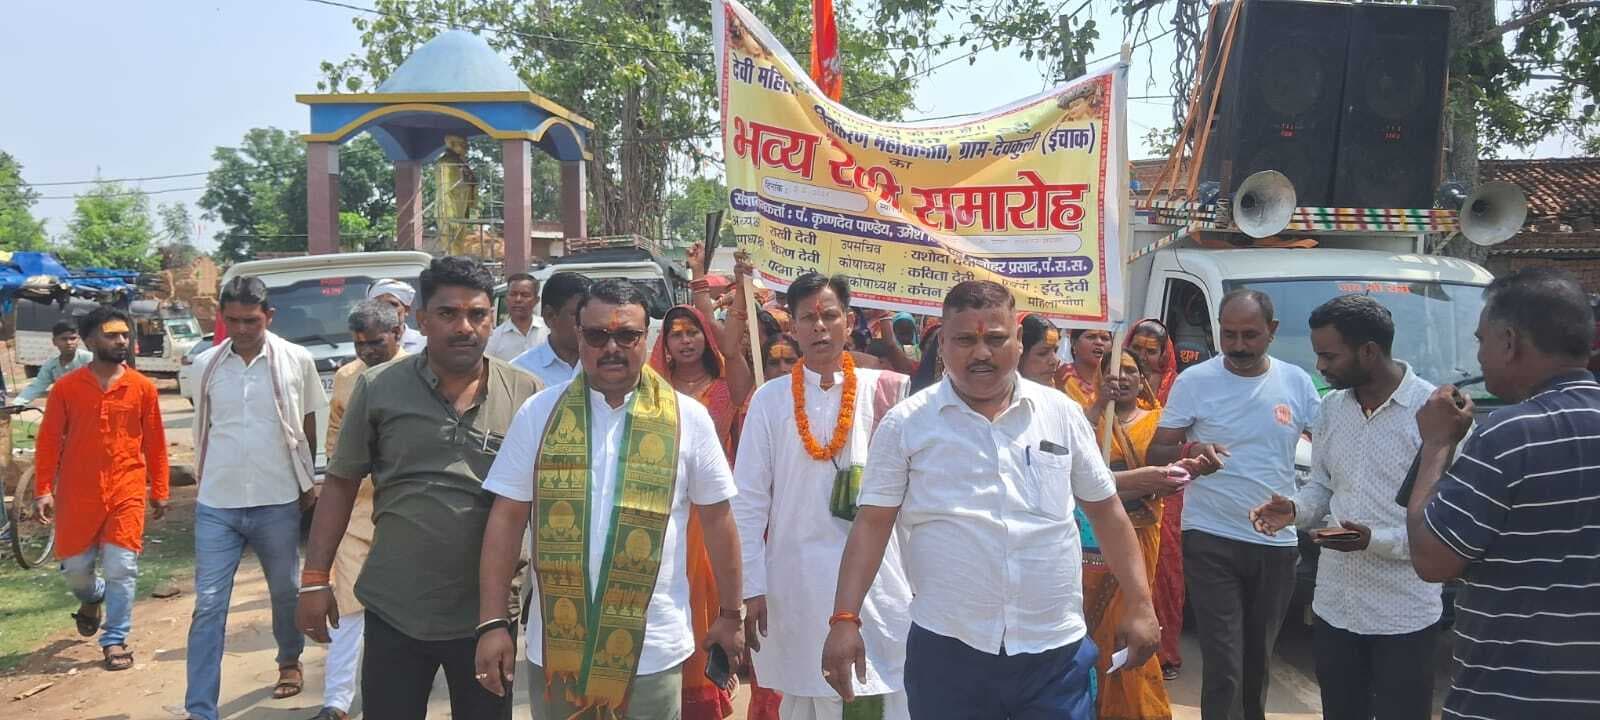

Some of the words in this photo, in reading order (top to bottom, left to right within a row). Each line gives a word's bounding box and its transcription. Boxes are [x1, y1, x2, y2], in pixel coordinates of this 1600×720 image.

[733, 52, 755, 84] देवी
[889, 157, 913, 170] का
[733, 116, 822, 180] भव्य
[911, 170, 1090, 232] समारोह
[795, 229, 817, 246] देवी
[798, 248, 820, 264] देवी
[908, 265, 948, 281] कविता
[908, 283, 942, 298] कंचन
[1064, 279, 1089, 292] देवी
